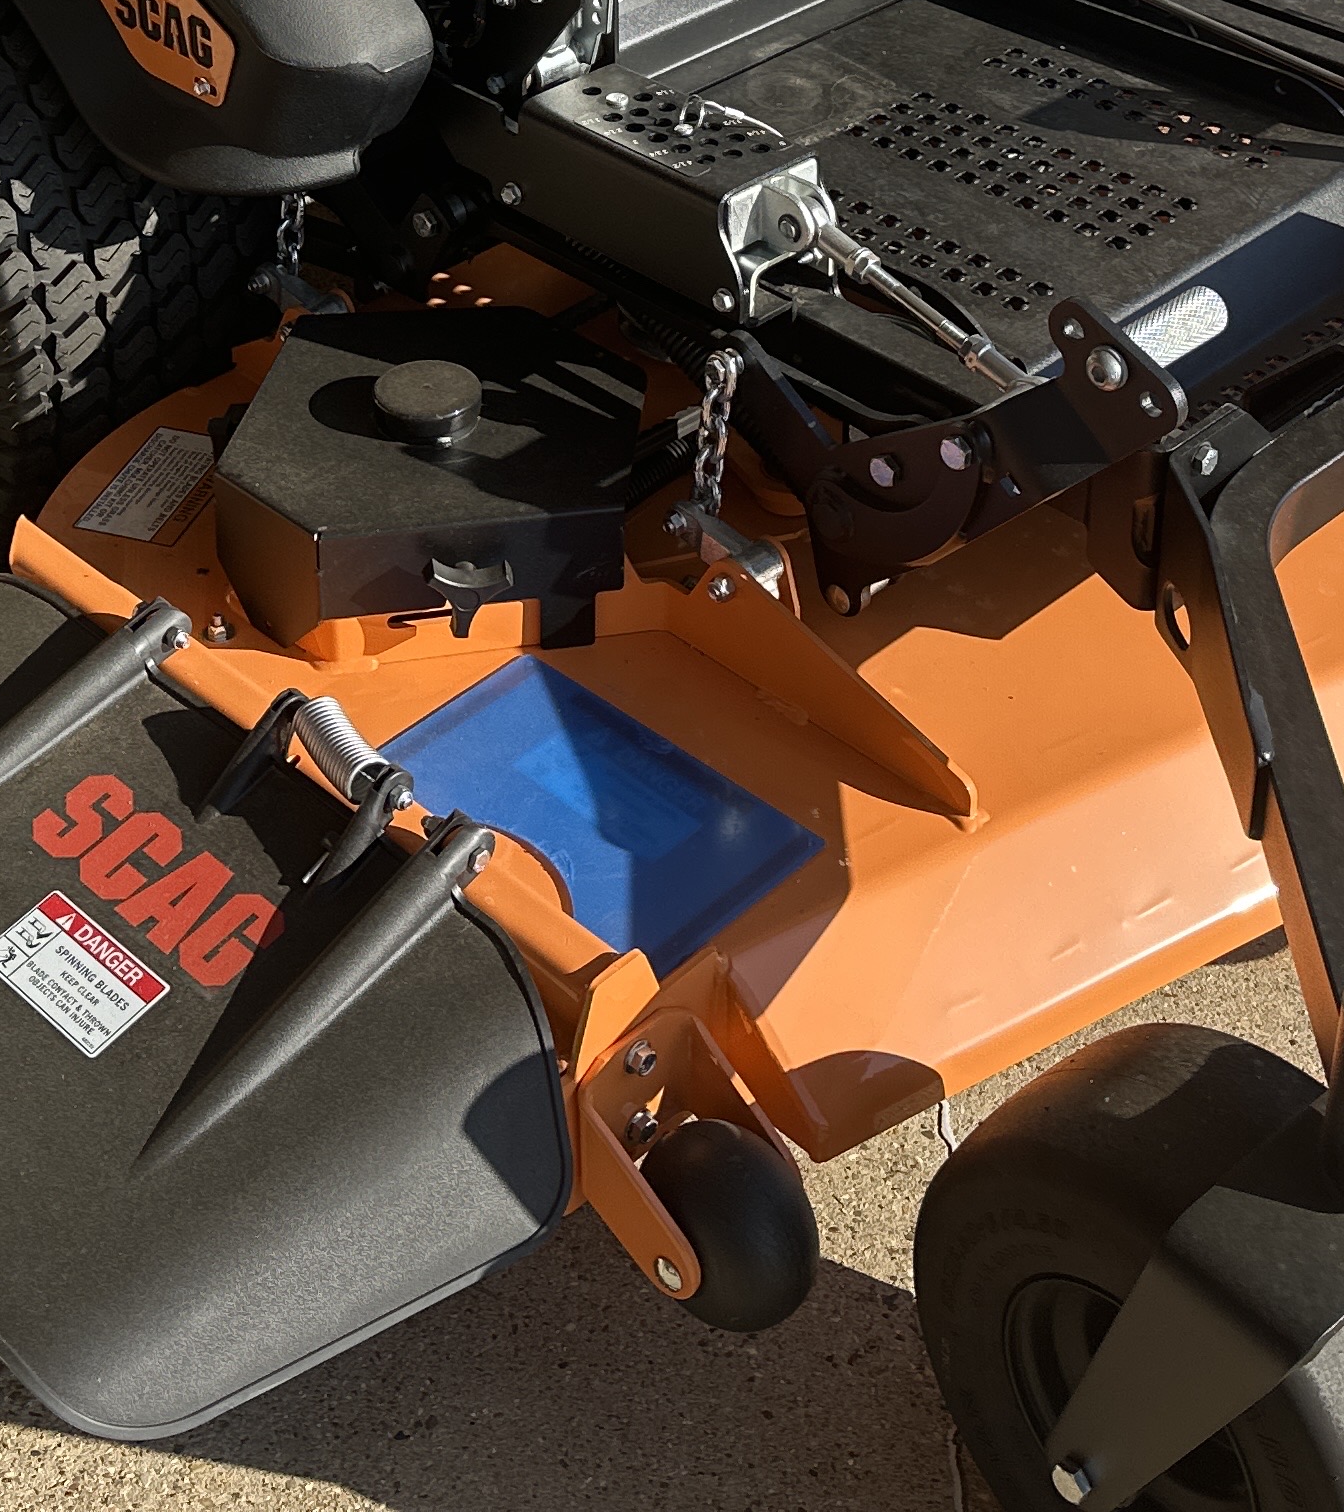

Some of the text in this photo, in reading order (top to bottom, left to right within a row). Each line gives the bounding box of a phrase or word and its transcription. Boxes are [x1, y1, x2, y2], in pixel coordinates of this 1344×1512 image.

[131, 432, 164, 464] DISCHARGE
[156, 444, 173, 456] NOT
[115, 464, 136, 483] CHUTE
[134, 456, 162, 482] OPERATE
[103, 497, 117, 508] KIT
[114, 482, 140, 506] UNLESS
[161, 498, 180, 513] AND
[95, 507, 109, 517] OR
[97, 505, 120, 526] GRASS
[145, 512, 168, 532] BELTS
[32, 774, 285, 986] SCAG
[74, 924, 144, 987] DANGER
[55, 945, 130, 1012] SPINNING BLADES
[60, 970, 100, 1006] KEEP CLEAR
[26, 960, 48, 980] BLADE
[47, 978, 78, 1006] CONTACT
[82, 1009, 112, 1036] THROWN
[28, 975, 95, 1036] OBJECTS CAN INJURE
